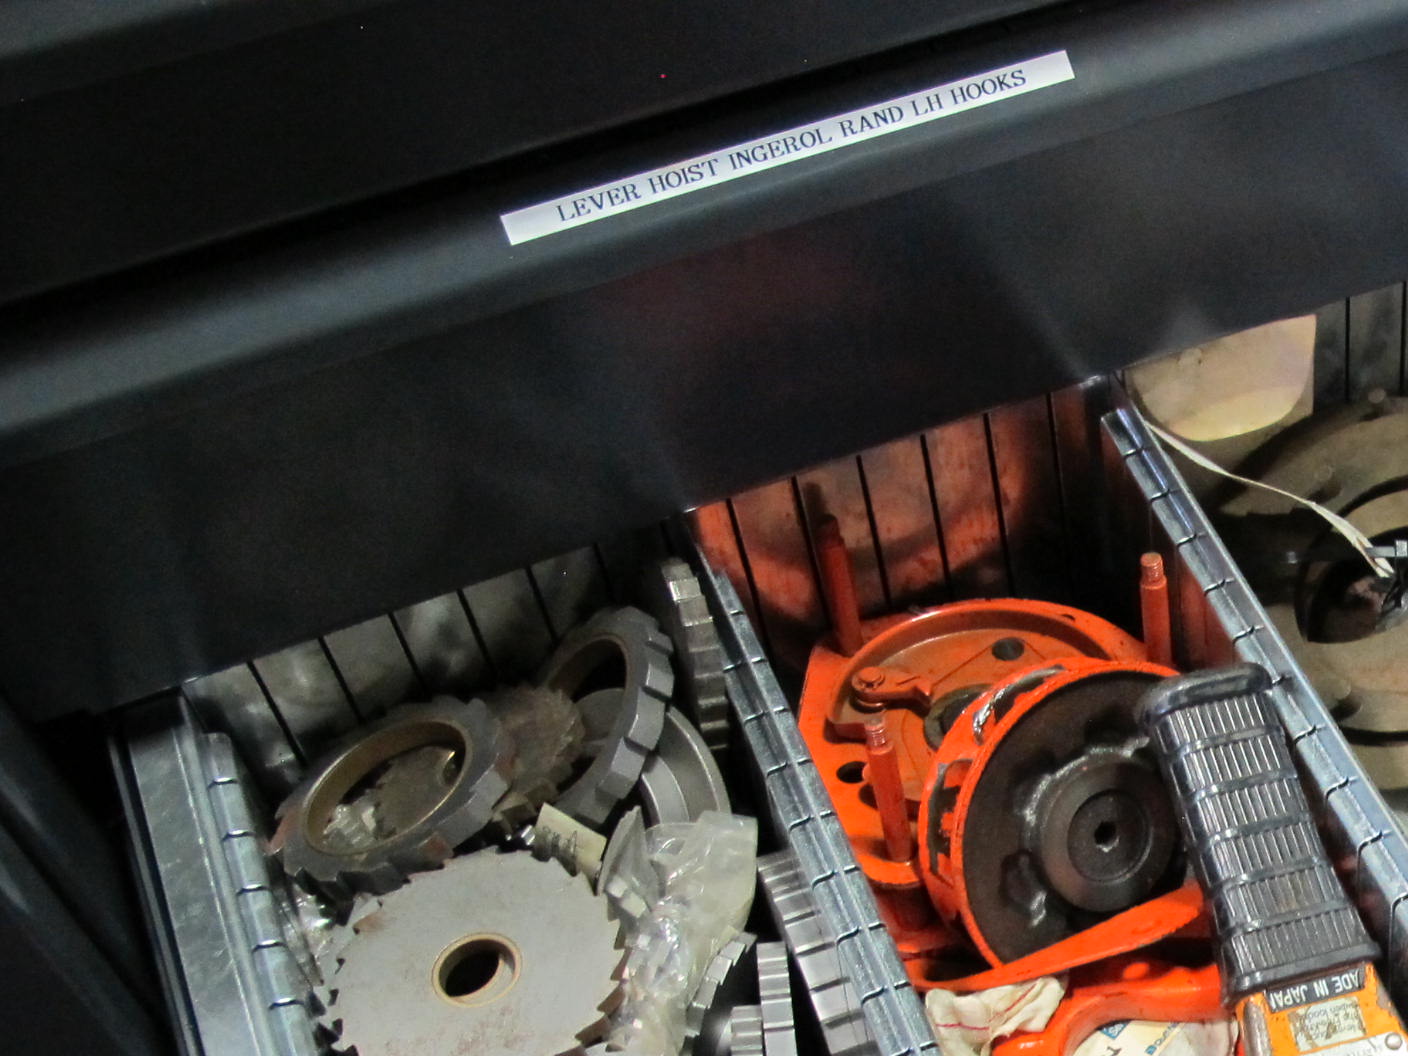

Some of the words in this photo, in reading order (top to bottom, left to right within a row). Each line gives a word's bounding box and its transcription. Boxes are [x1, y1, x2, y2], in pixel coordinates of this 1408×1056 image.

[556, 182, 642, 223] LEVER
[648, 157, 720, 195] HOIST
[728, 128, 833, 172] INGEROL
[838, 106, 906, 139] RAND
[910, 93, 944, 118] LH
[951, 68, 1027, 108] HOOKS
[1313, 983, 1330, 1000] IN
[1333, 970, 1362, 994] ADE
